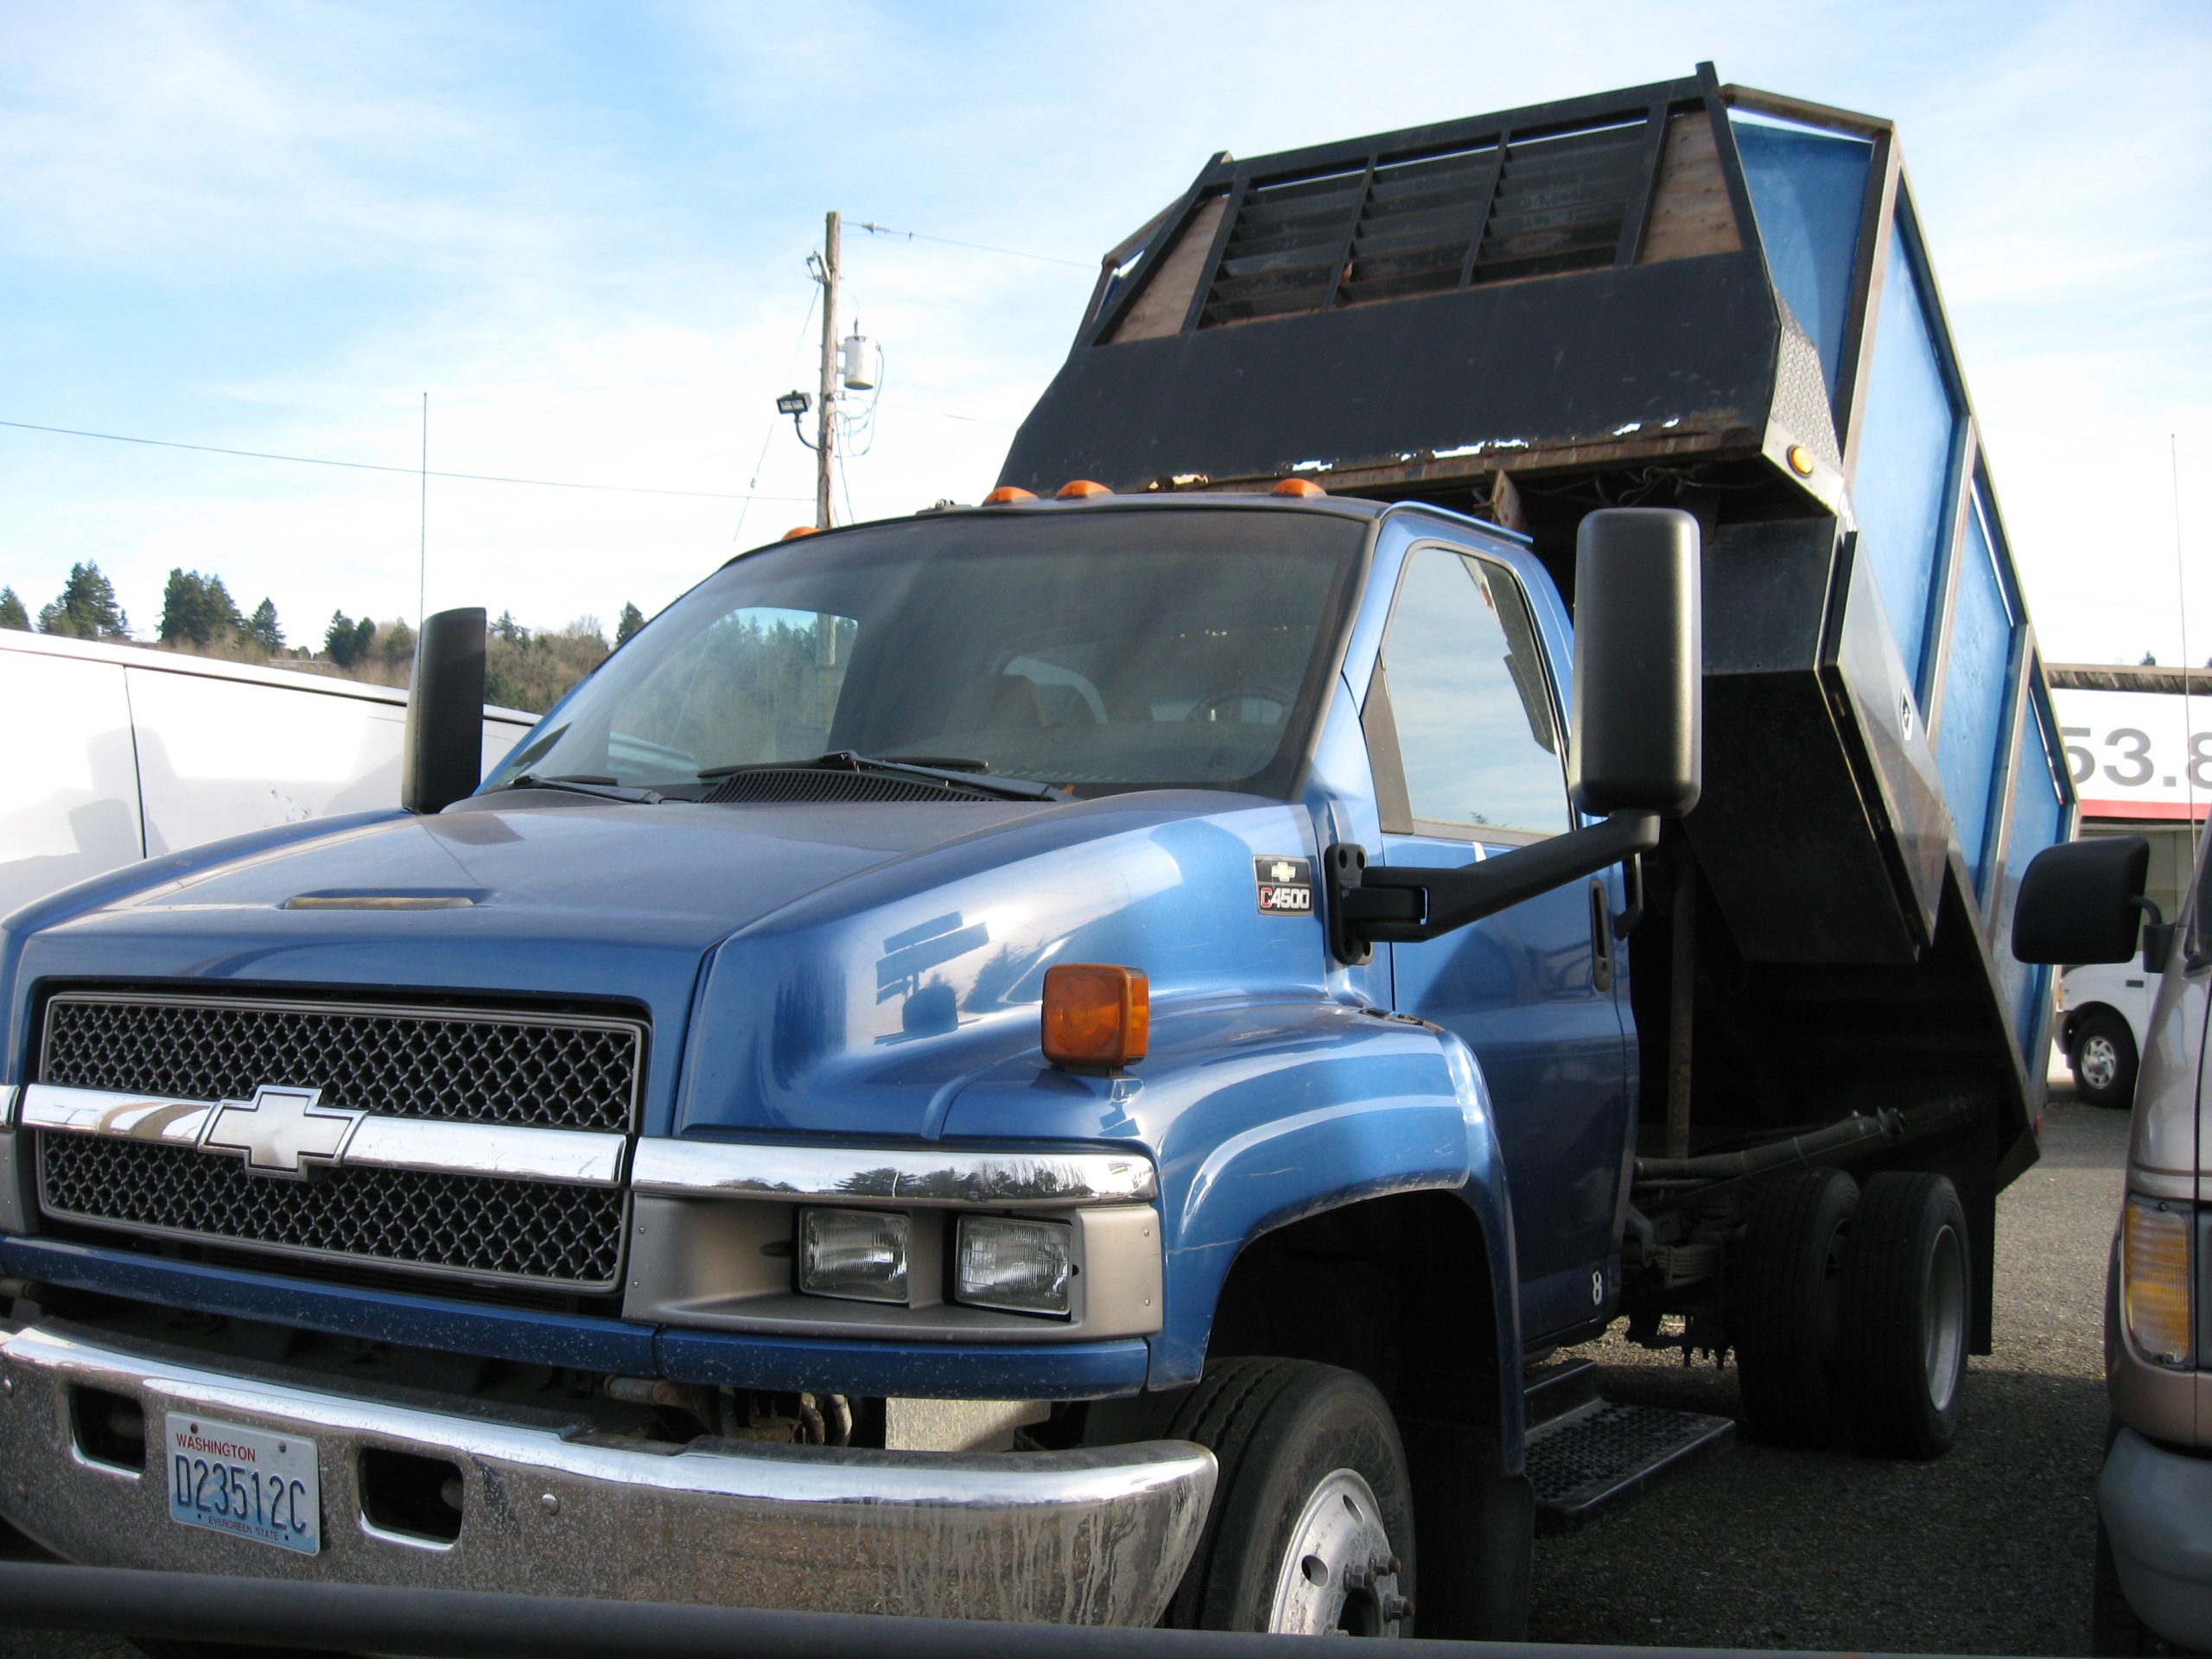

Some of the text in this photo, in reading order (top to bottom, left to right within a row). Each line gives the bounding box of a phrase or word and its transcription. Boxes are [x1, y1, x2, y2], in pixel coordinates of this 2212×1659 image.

[1261, 887, 1310, 908] C4500
[1592, 1271, 1603, 1306] 8
[176, 1433, 256, 1462] WASHINGTON
[175, 1454, 306, 1533] D23512C
[208, 1516, 279, 1541] EVERGREEN STATE
